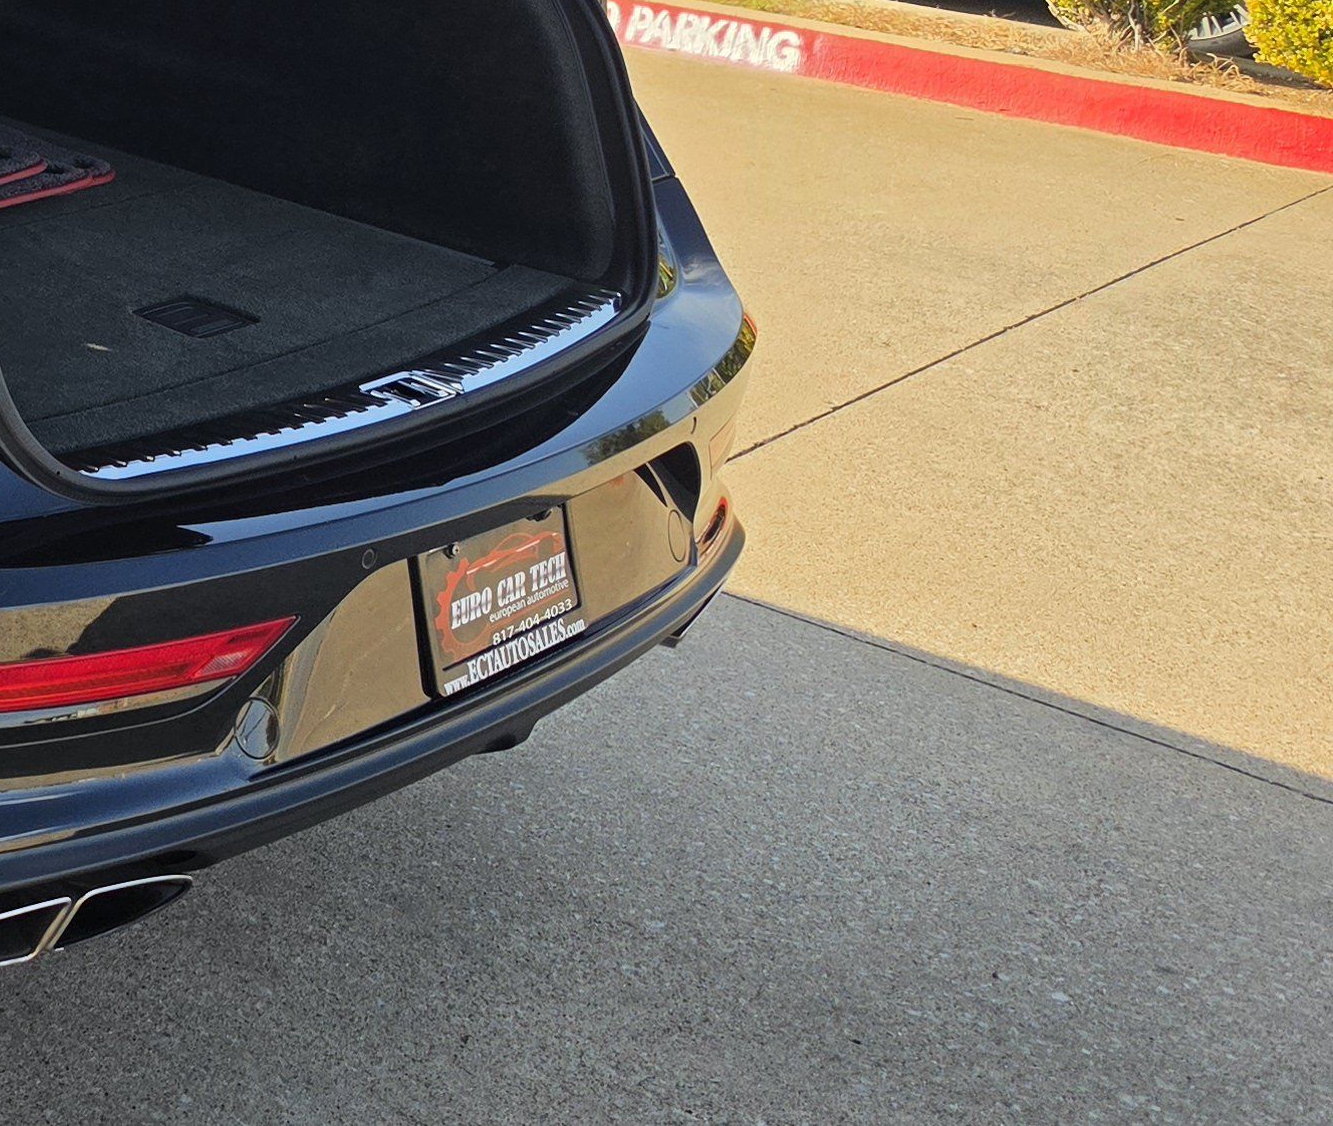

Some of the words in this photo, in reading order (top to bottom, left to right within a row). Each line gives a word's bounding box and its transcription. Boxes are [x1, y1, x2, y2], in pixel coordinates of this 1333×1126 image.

[624, 5, 802, 73] PARKING
[451, 587, 493, 630] EURO
[497, 571, 527, 608] CAR
[529, 552, 567, 592] TECH
[489, 599, 527, 623] european
[527, 579, 569, 605] automotive
[492, 599, 573, 645] 817-404-4033
[444, 619, 586, 696] www.ECTAUTOSALES.com
